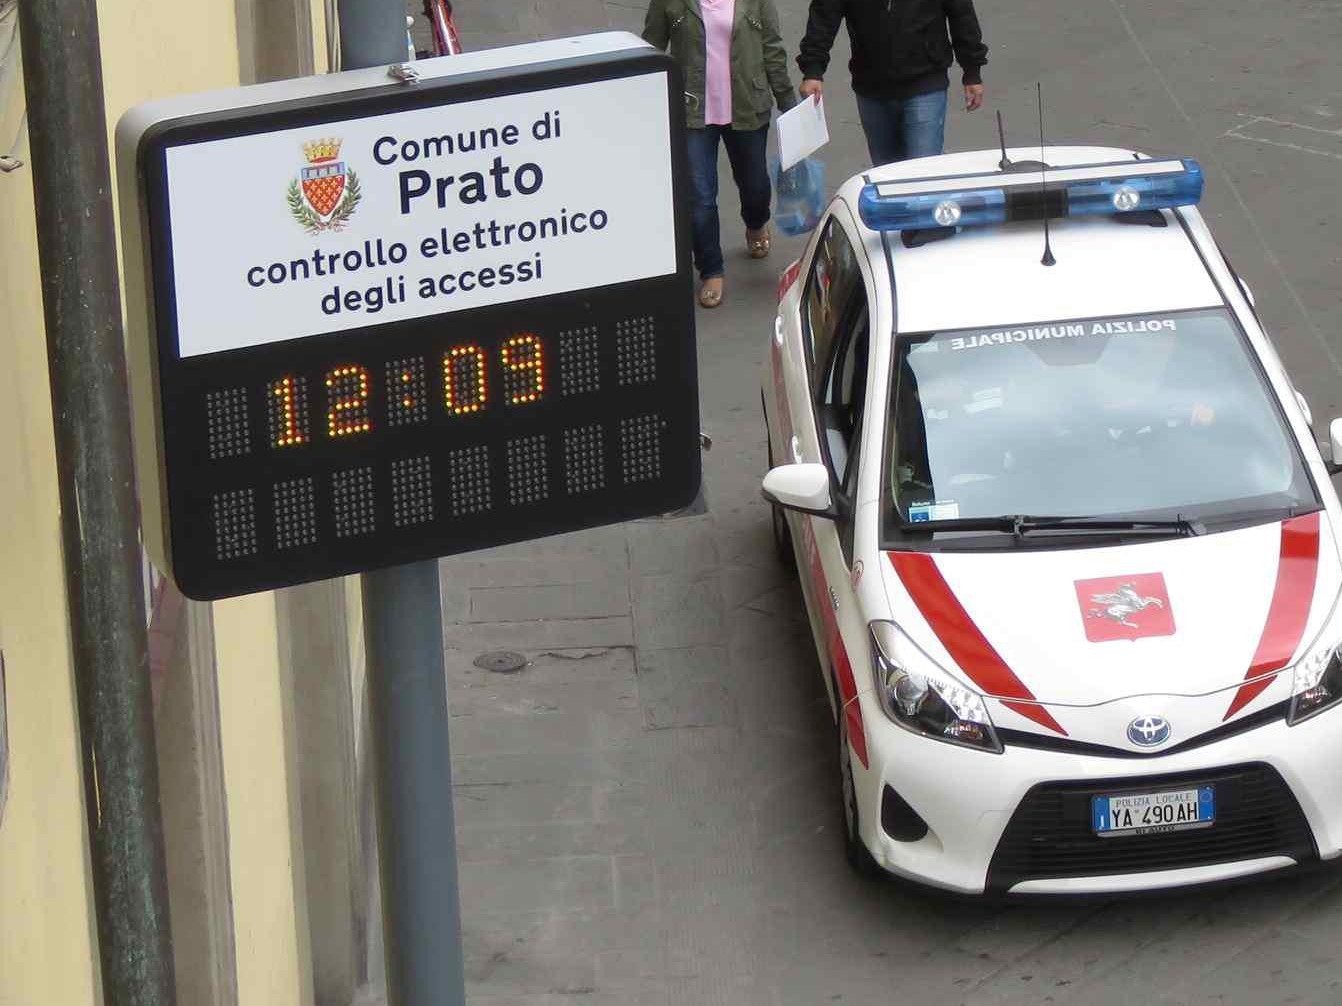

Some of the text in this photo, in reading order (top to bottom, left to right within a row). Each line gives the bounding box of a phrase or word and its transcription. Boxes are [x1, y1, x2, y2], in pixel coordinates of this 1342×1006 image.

[372, 110, 562, 165] Comune di
[399, 156, 544, 215] Prato
[247, 208, 609, 287] controllo elettronico
[320, 251, 543, 314] degli accessi
[273, 334, 545, 448] 12:09
